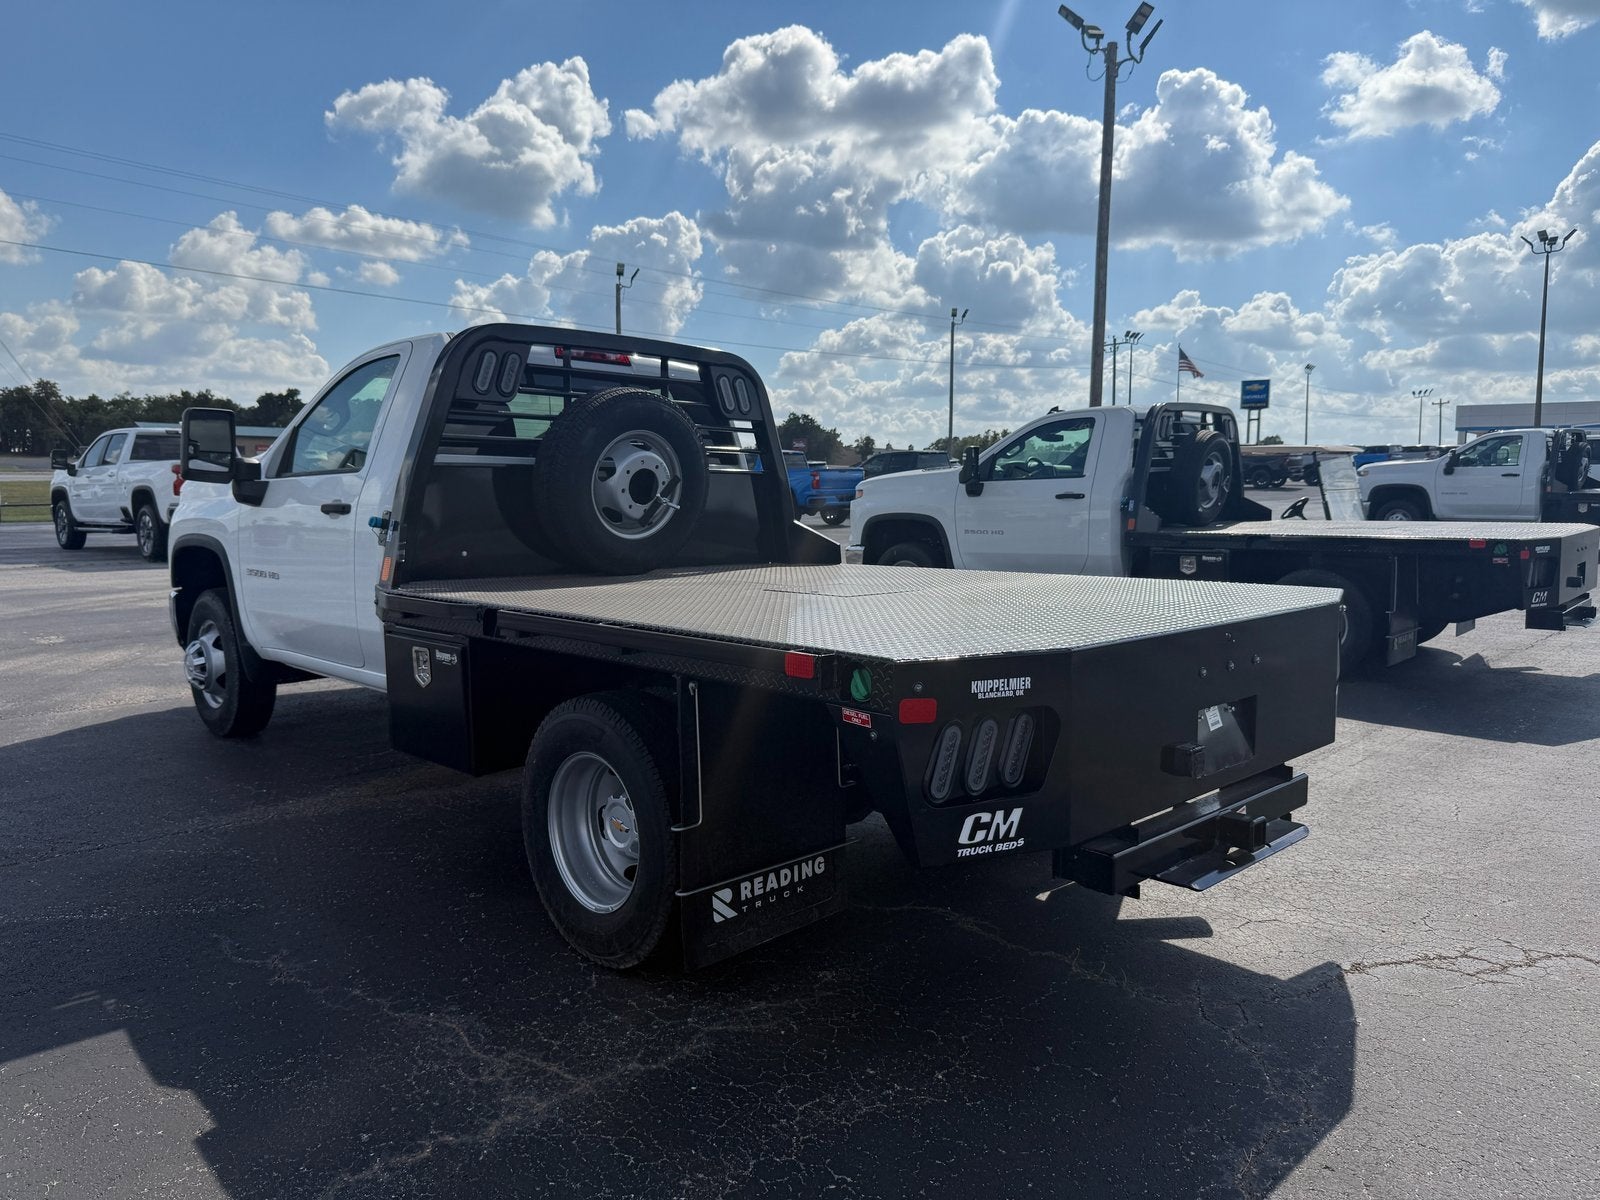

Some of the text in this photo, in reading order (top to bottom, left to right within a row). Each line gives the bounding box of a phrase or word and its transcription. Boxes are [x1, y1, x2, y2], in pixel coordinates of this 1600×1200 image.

[1532, 591, 1548, 603] CM
[971, 677, 1031, 693] KNIPPELMIER
[977, 689, 1024, 699] BLANCHARD, OK
[958, 807, 1023, 844] CM
[957, 837, 1025, 858] TRUCK BEDS
[740, 856, 825, 900] READING
[741, 885, 804, 913] TRUCK
